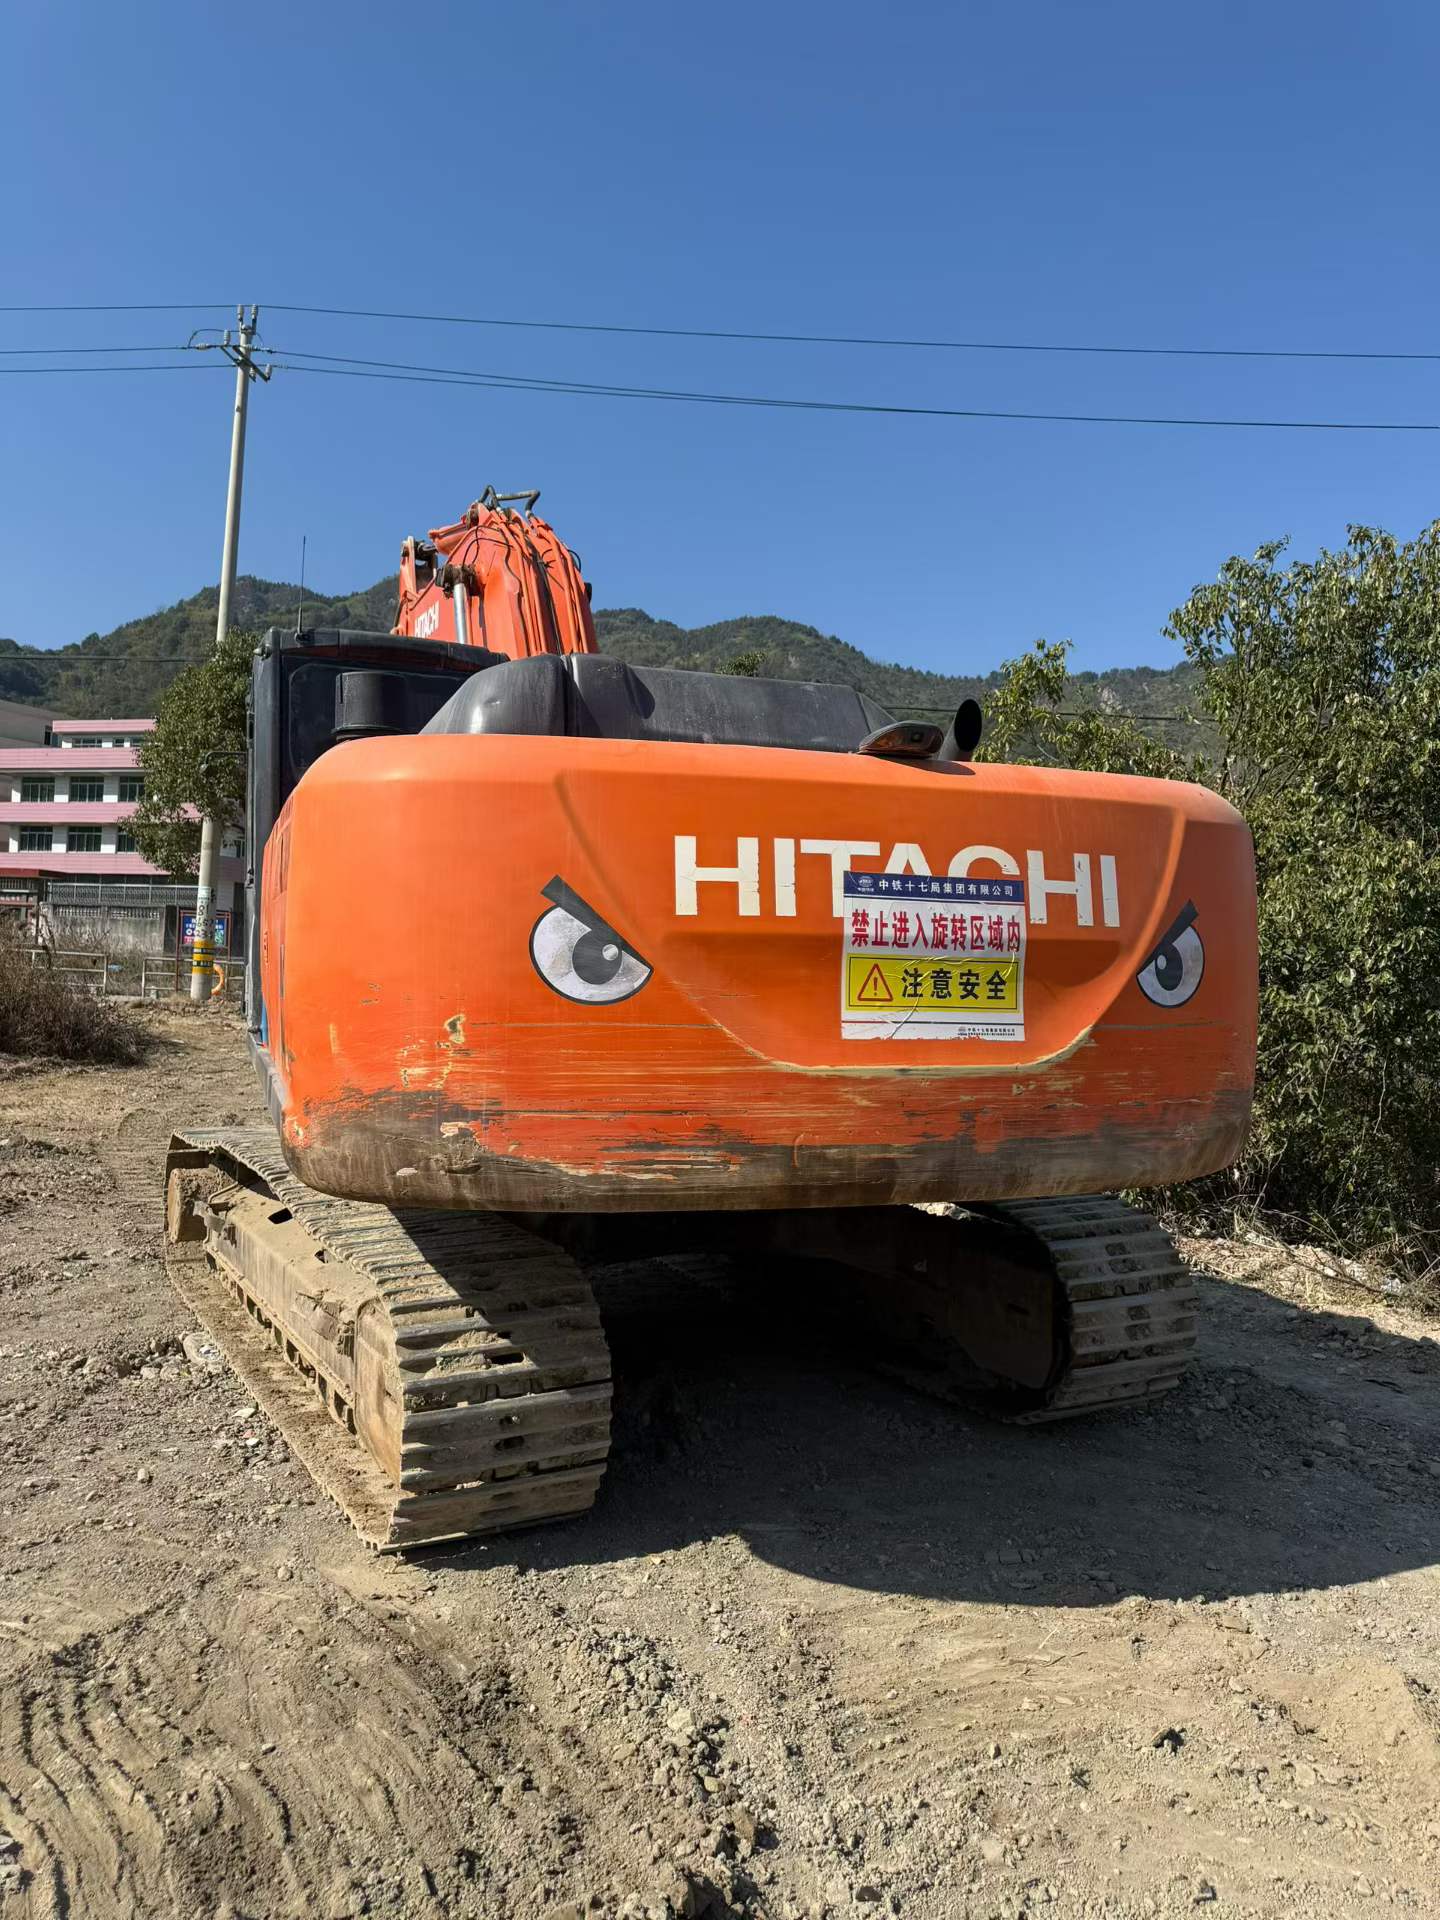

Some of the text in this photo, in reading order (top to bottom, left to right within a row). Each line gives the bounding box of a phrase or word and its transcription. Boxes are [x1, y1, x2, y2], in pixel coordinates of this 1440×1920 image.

[878, 879, 1014, 897] 中铁十七局集团有限公司
[851, 909, 1021, 953] 禁止进入旋转区域内
[901, 967, 1008, 1001] 注意安全
